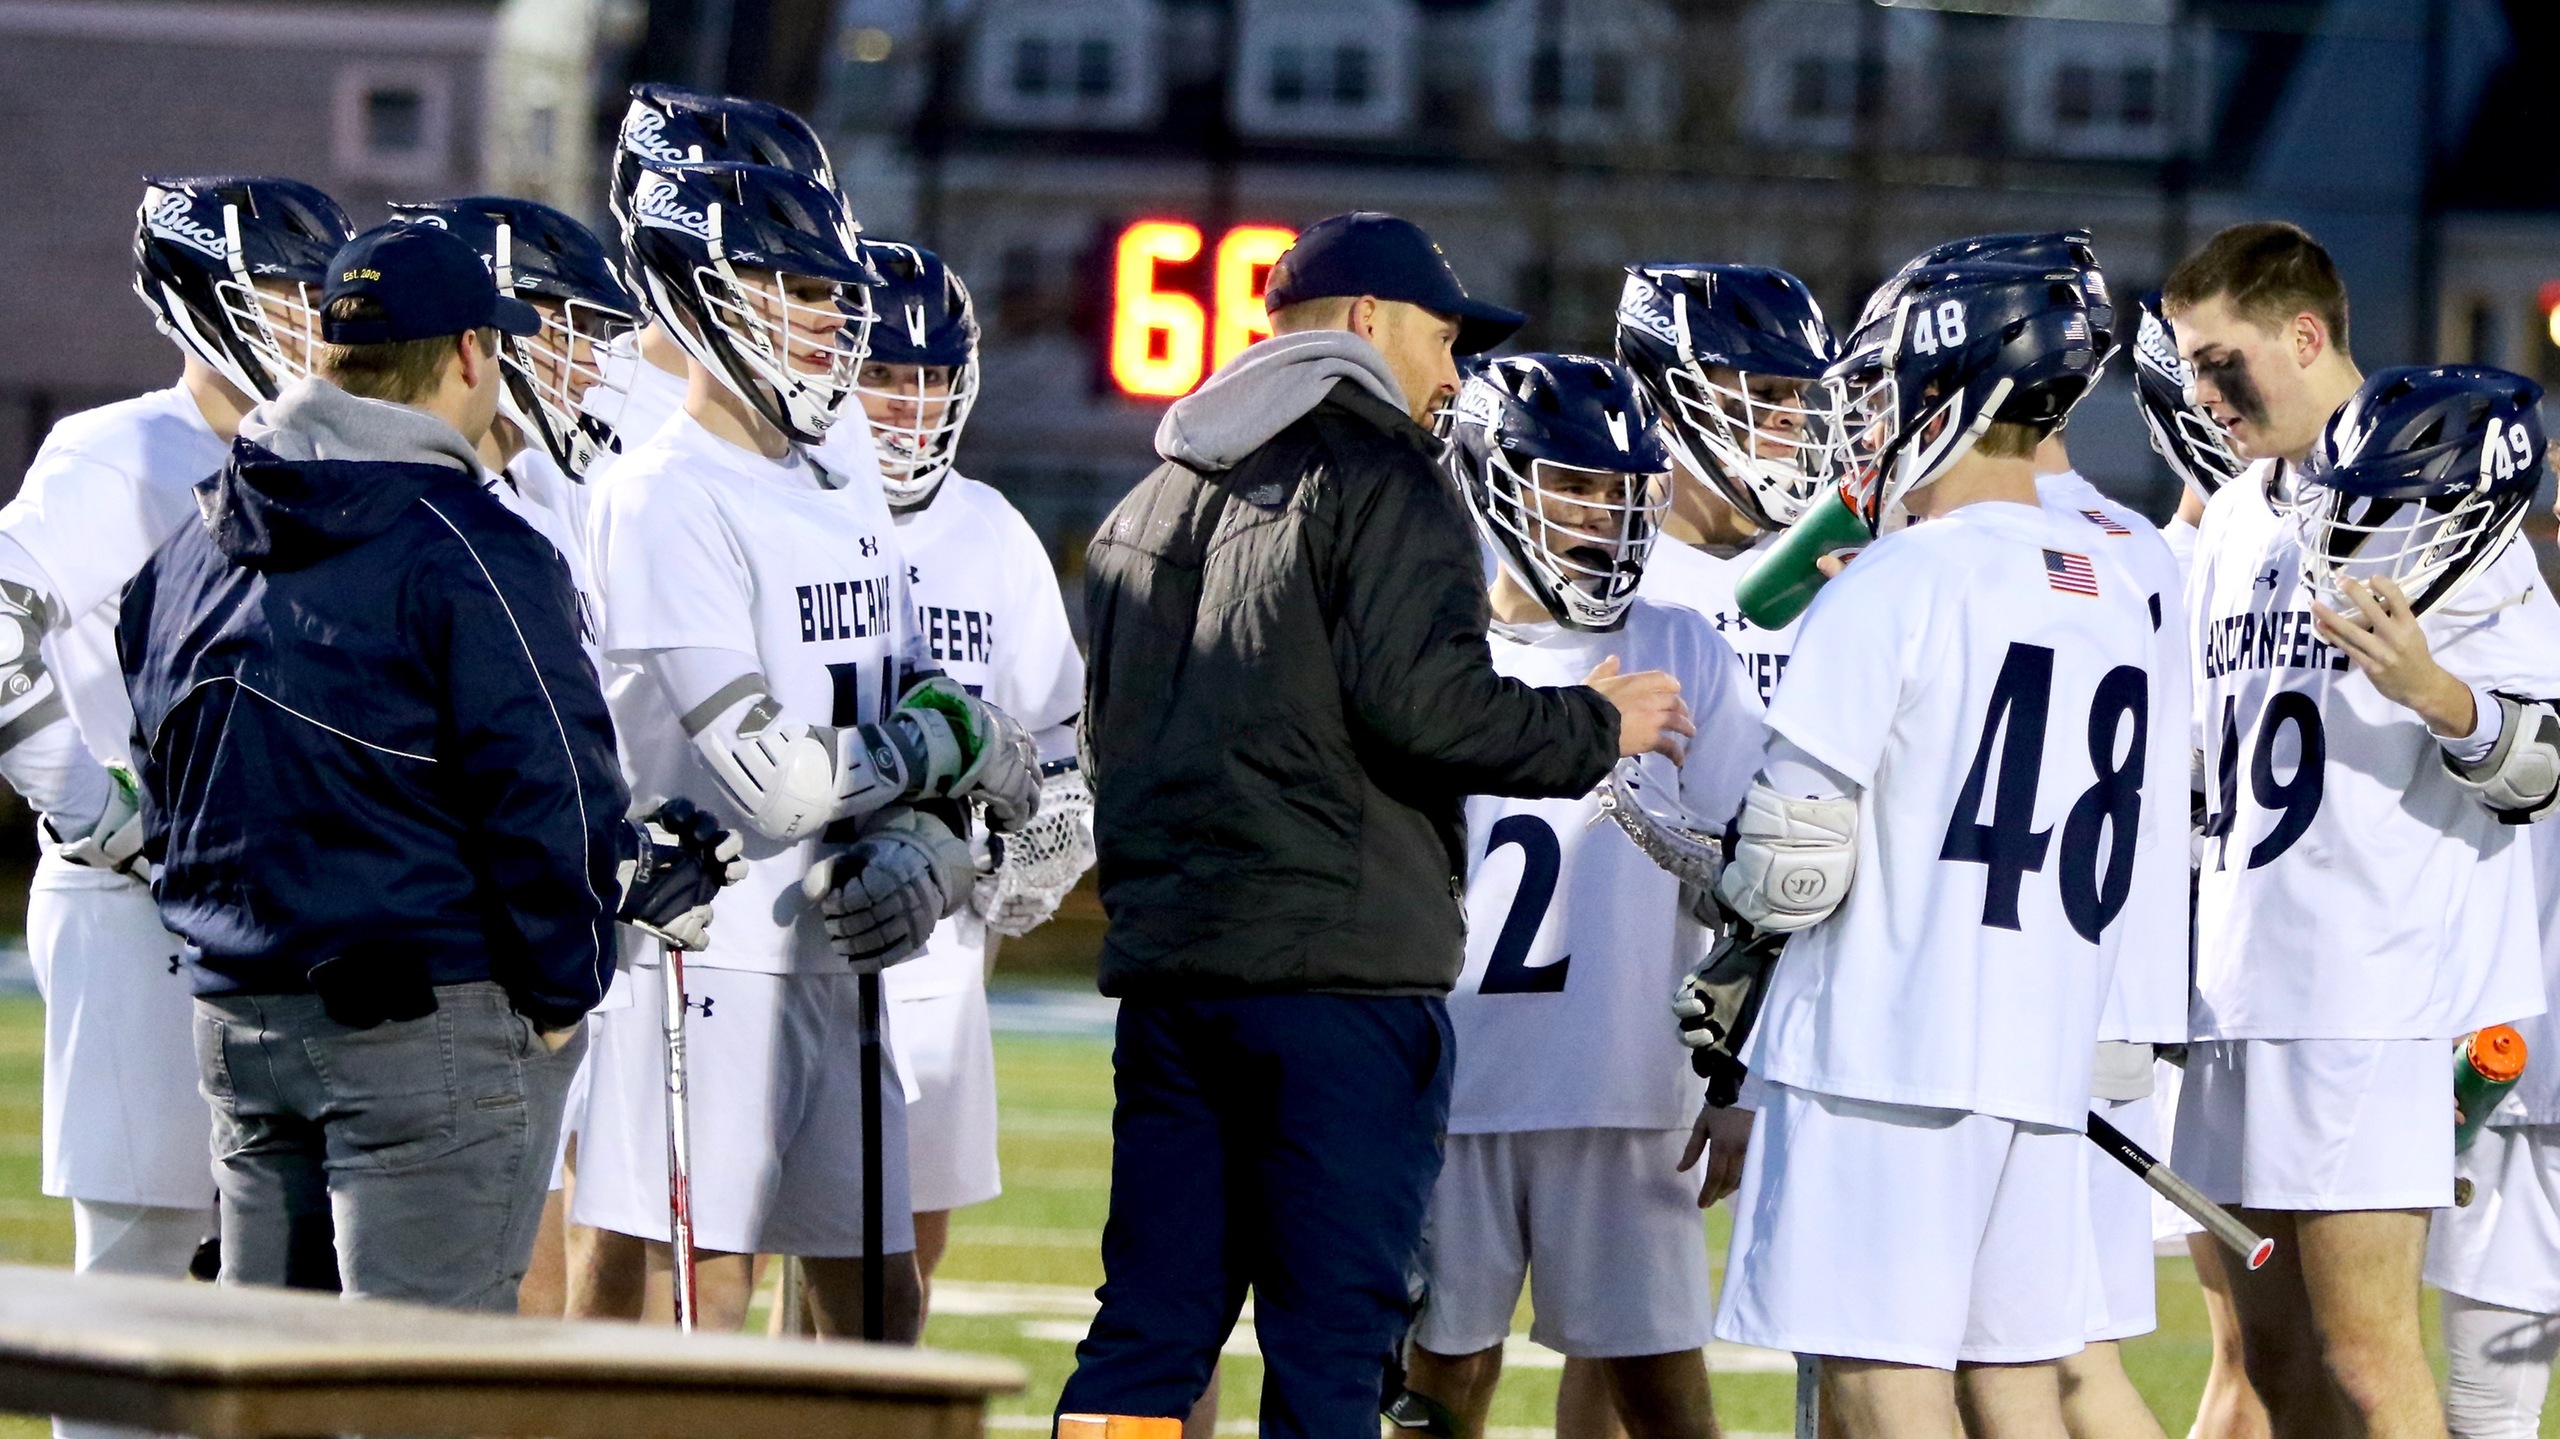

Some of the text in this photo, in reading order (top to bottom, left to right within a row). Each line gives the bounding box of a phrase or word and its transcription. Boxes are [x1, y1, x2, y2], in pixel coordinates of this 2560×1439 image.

[150, 191, 227, 255] Bucs
[1913, 300, 1967, 357] 48
[2495, 423, 2533, 480] 49
[1938, 641, 2148, 946] 48
[1478, 814, 1571, 994] 2
